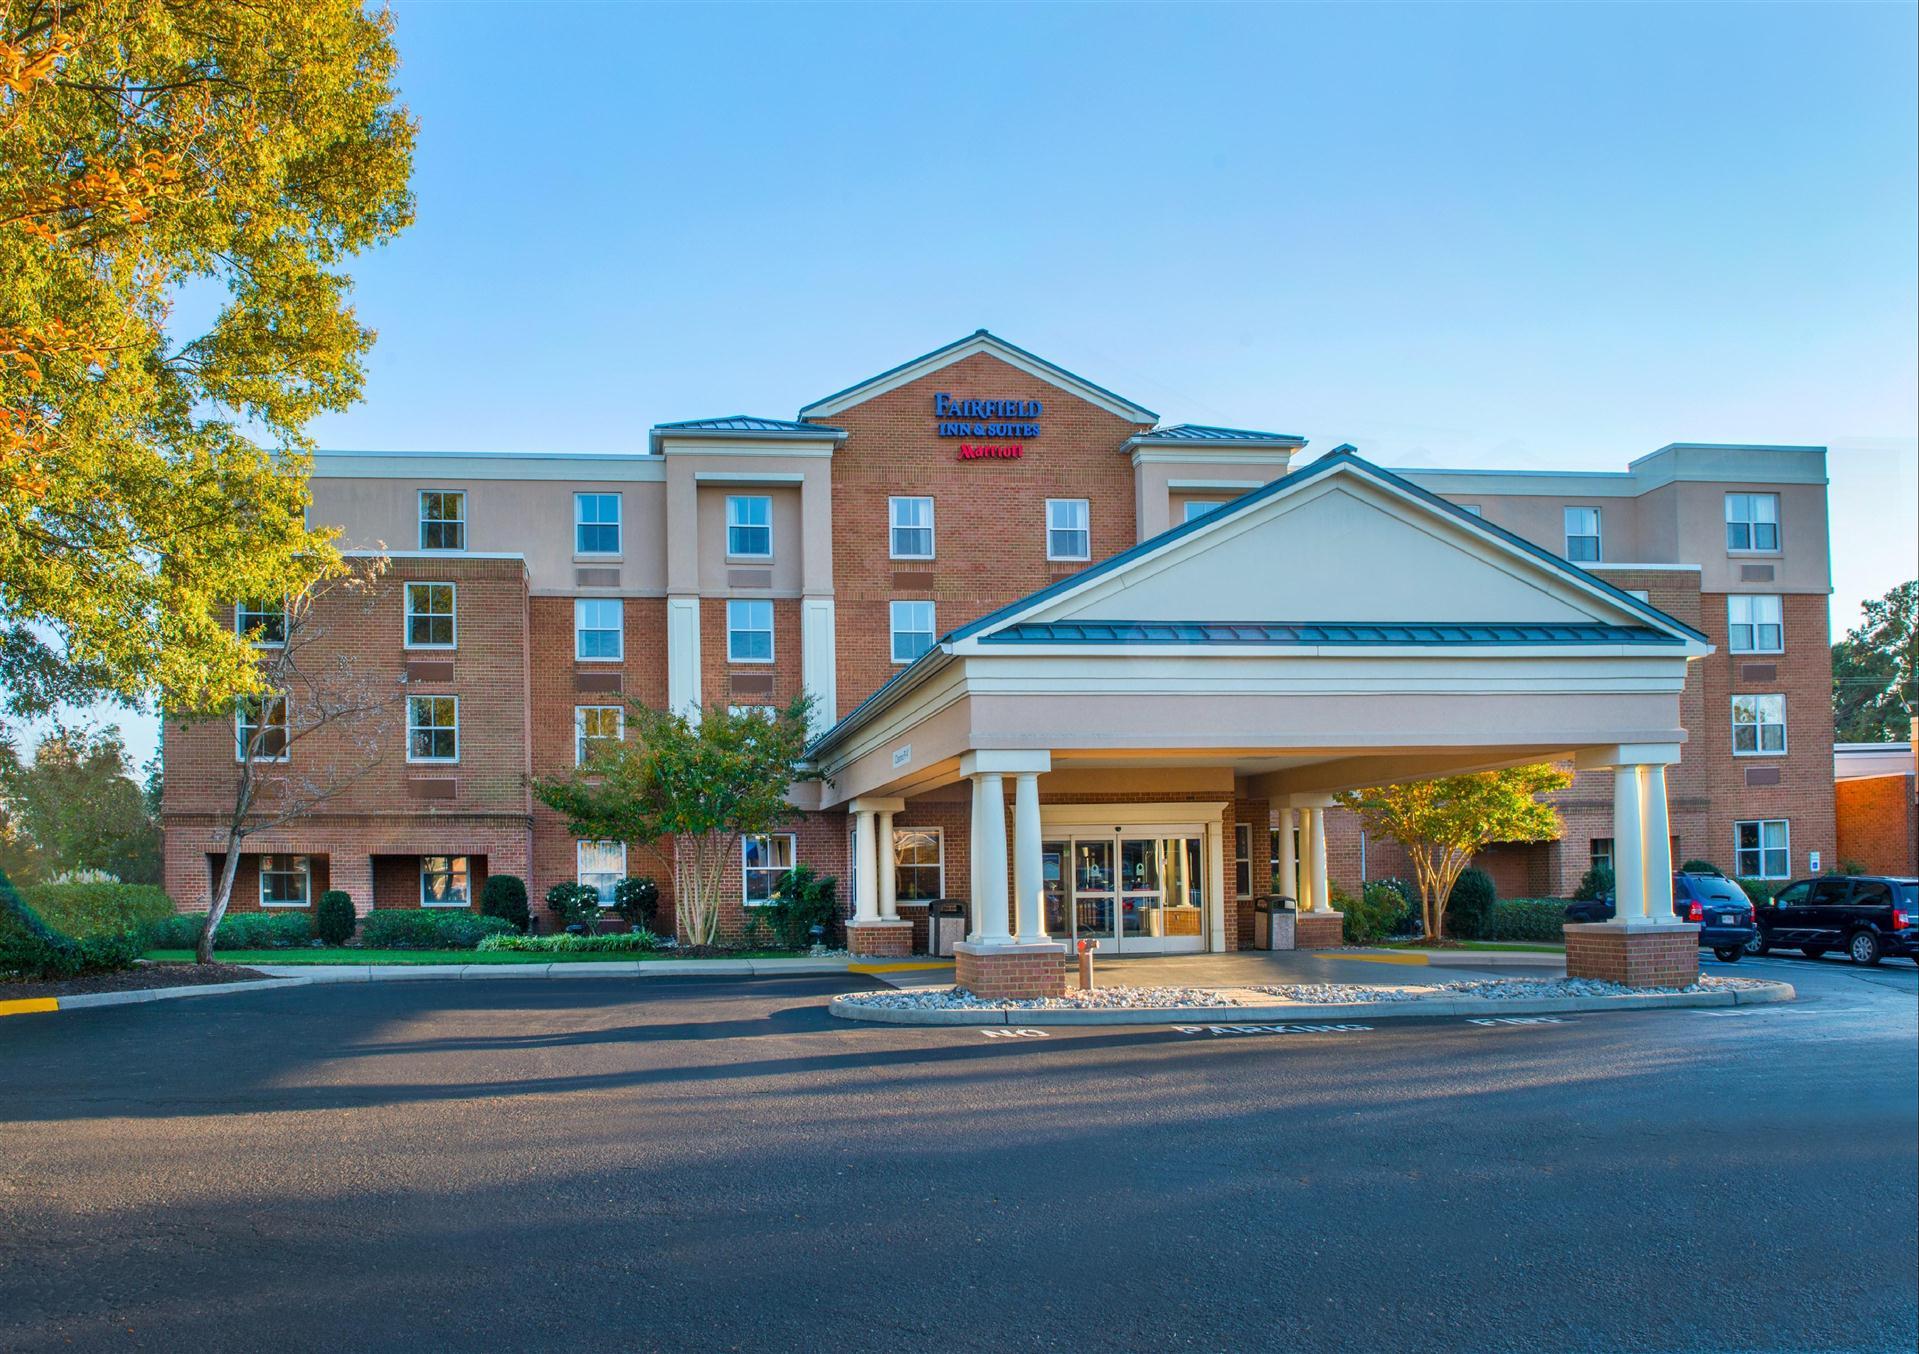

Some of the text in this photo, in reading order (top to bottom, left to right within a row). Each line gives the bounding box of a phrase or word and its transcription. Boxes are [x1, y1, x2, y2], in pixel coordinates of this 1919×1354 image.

[934, 392, 1044, 419] FAIRFIELD
[938, 422, 1041, 437] INN & SUITES
[958, 443, 1024, 461] Marriott
[980, 1029, 1050, 1038] NO
[1171, 1024, 1375, 1035] PARKING
